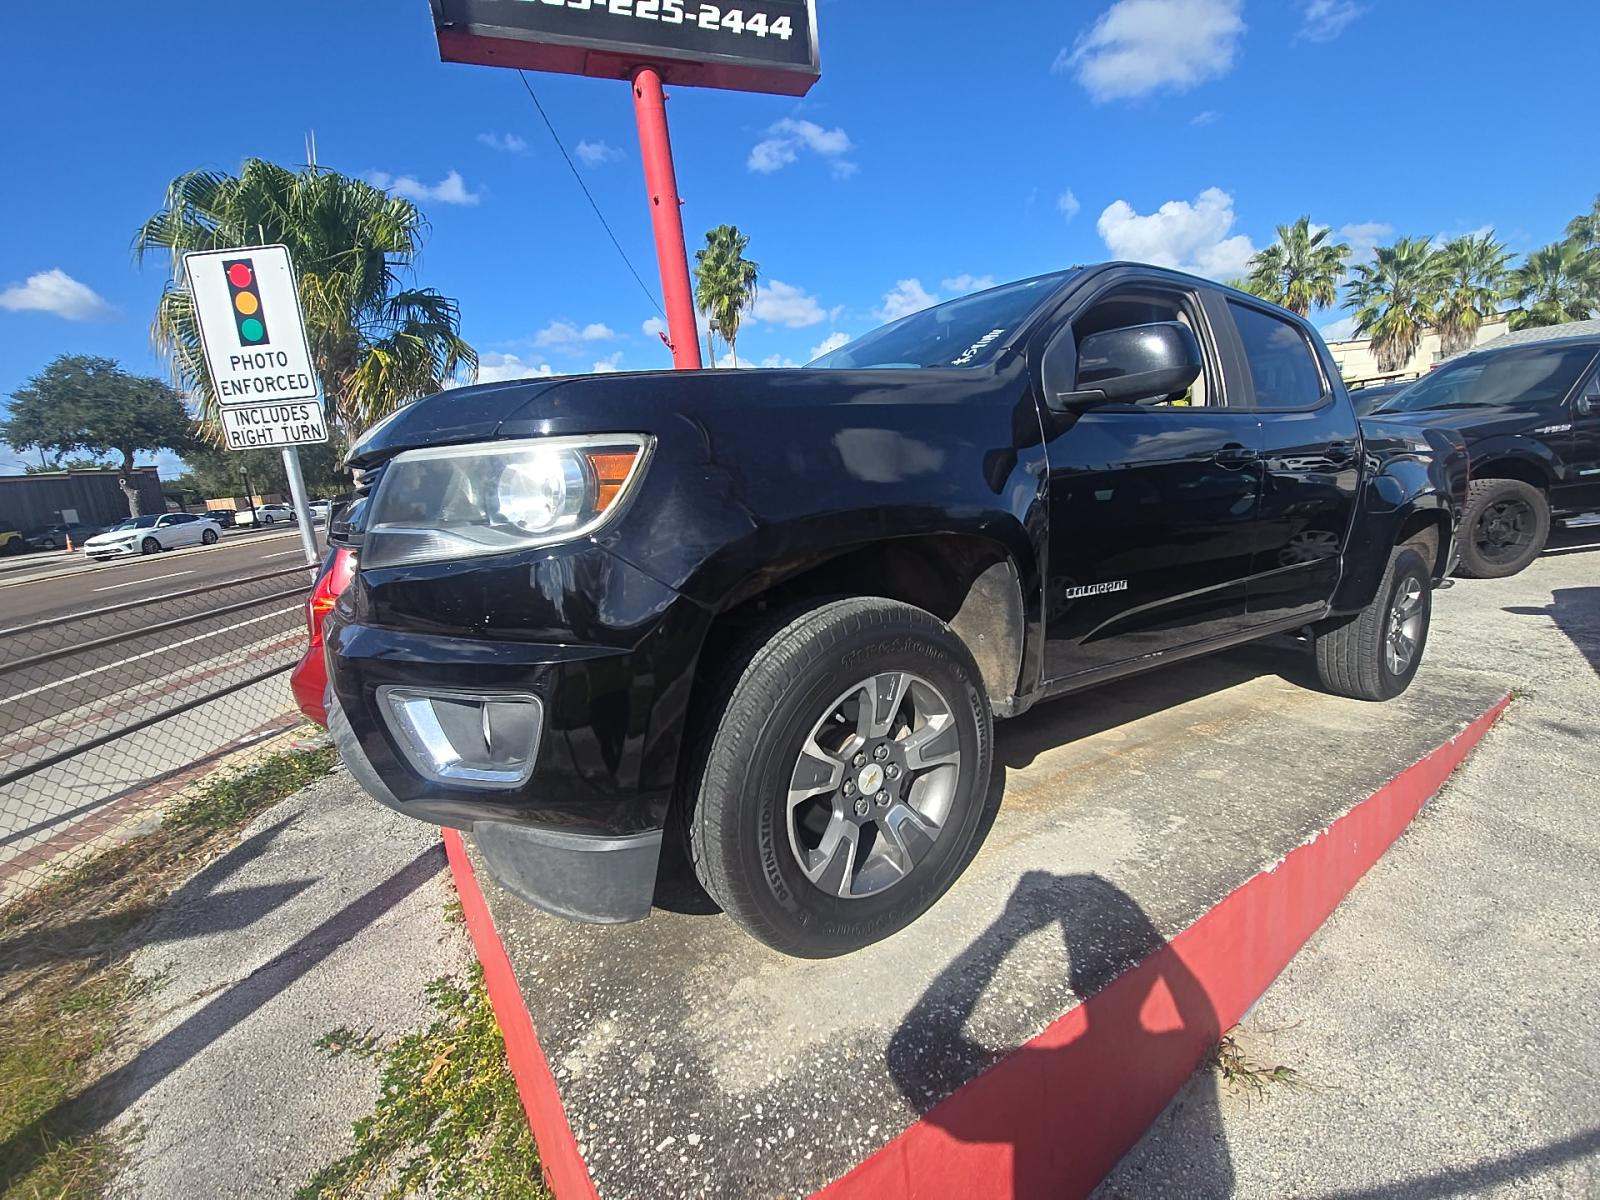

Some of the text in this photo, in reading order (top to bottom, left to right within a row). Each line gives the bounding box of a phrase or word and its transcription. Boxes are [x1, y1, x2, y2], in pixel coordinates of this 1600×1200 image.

[514, 0, 793, 40] -225-2444
[230, 351, 288, 371] PHOTO
[220, 373, 309, 396] ENFORCED
[234, 405, 310, 426] INCLUDES
[231, 424, 322, 445] RIGHT TURN
